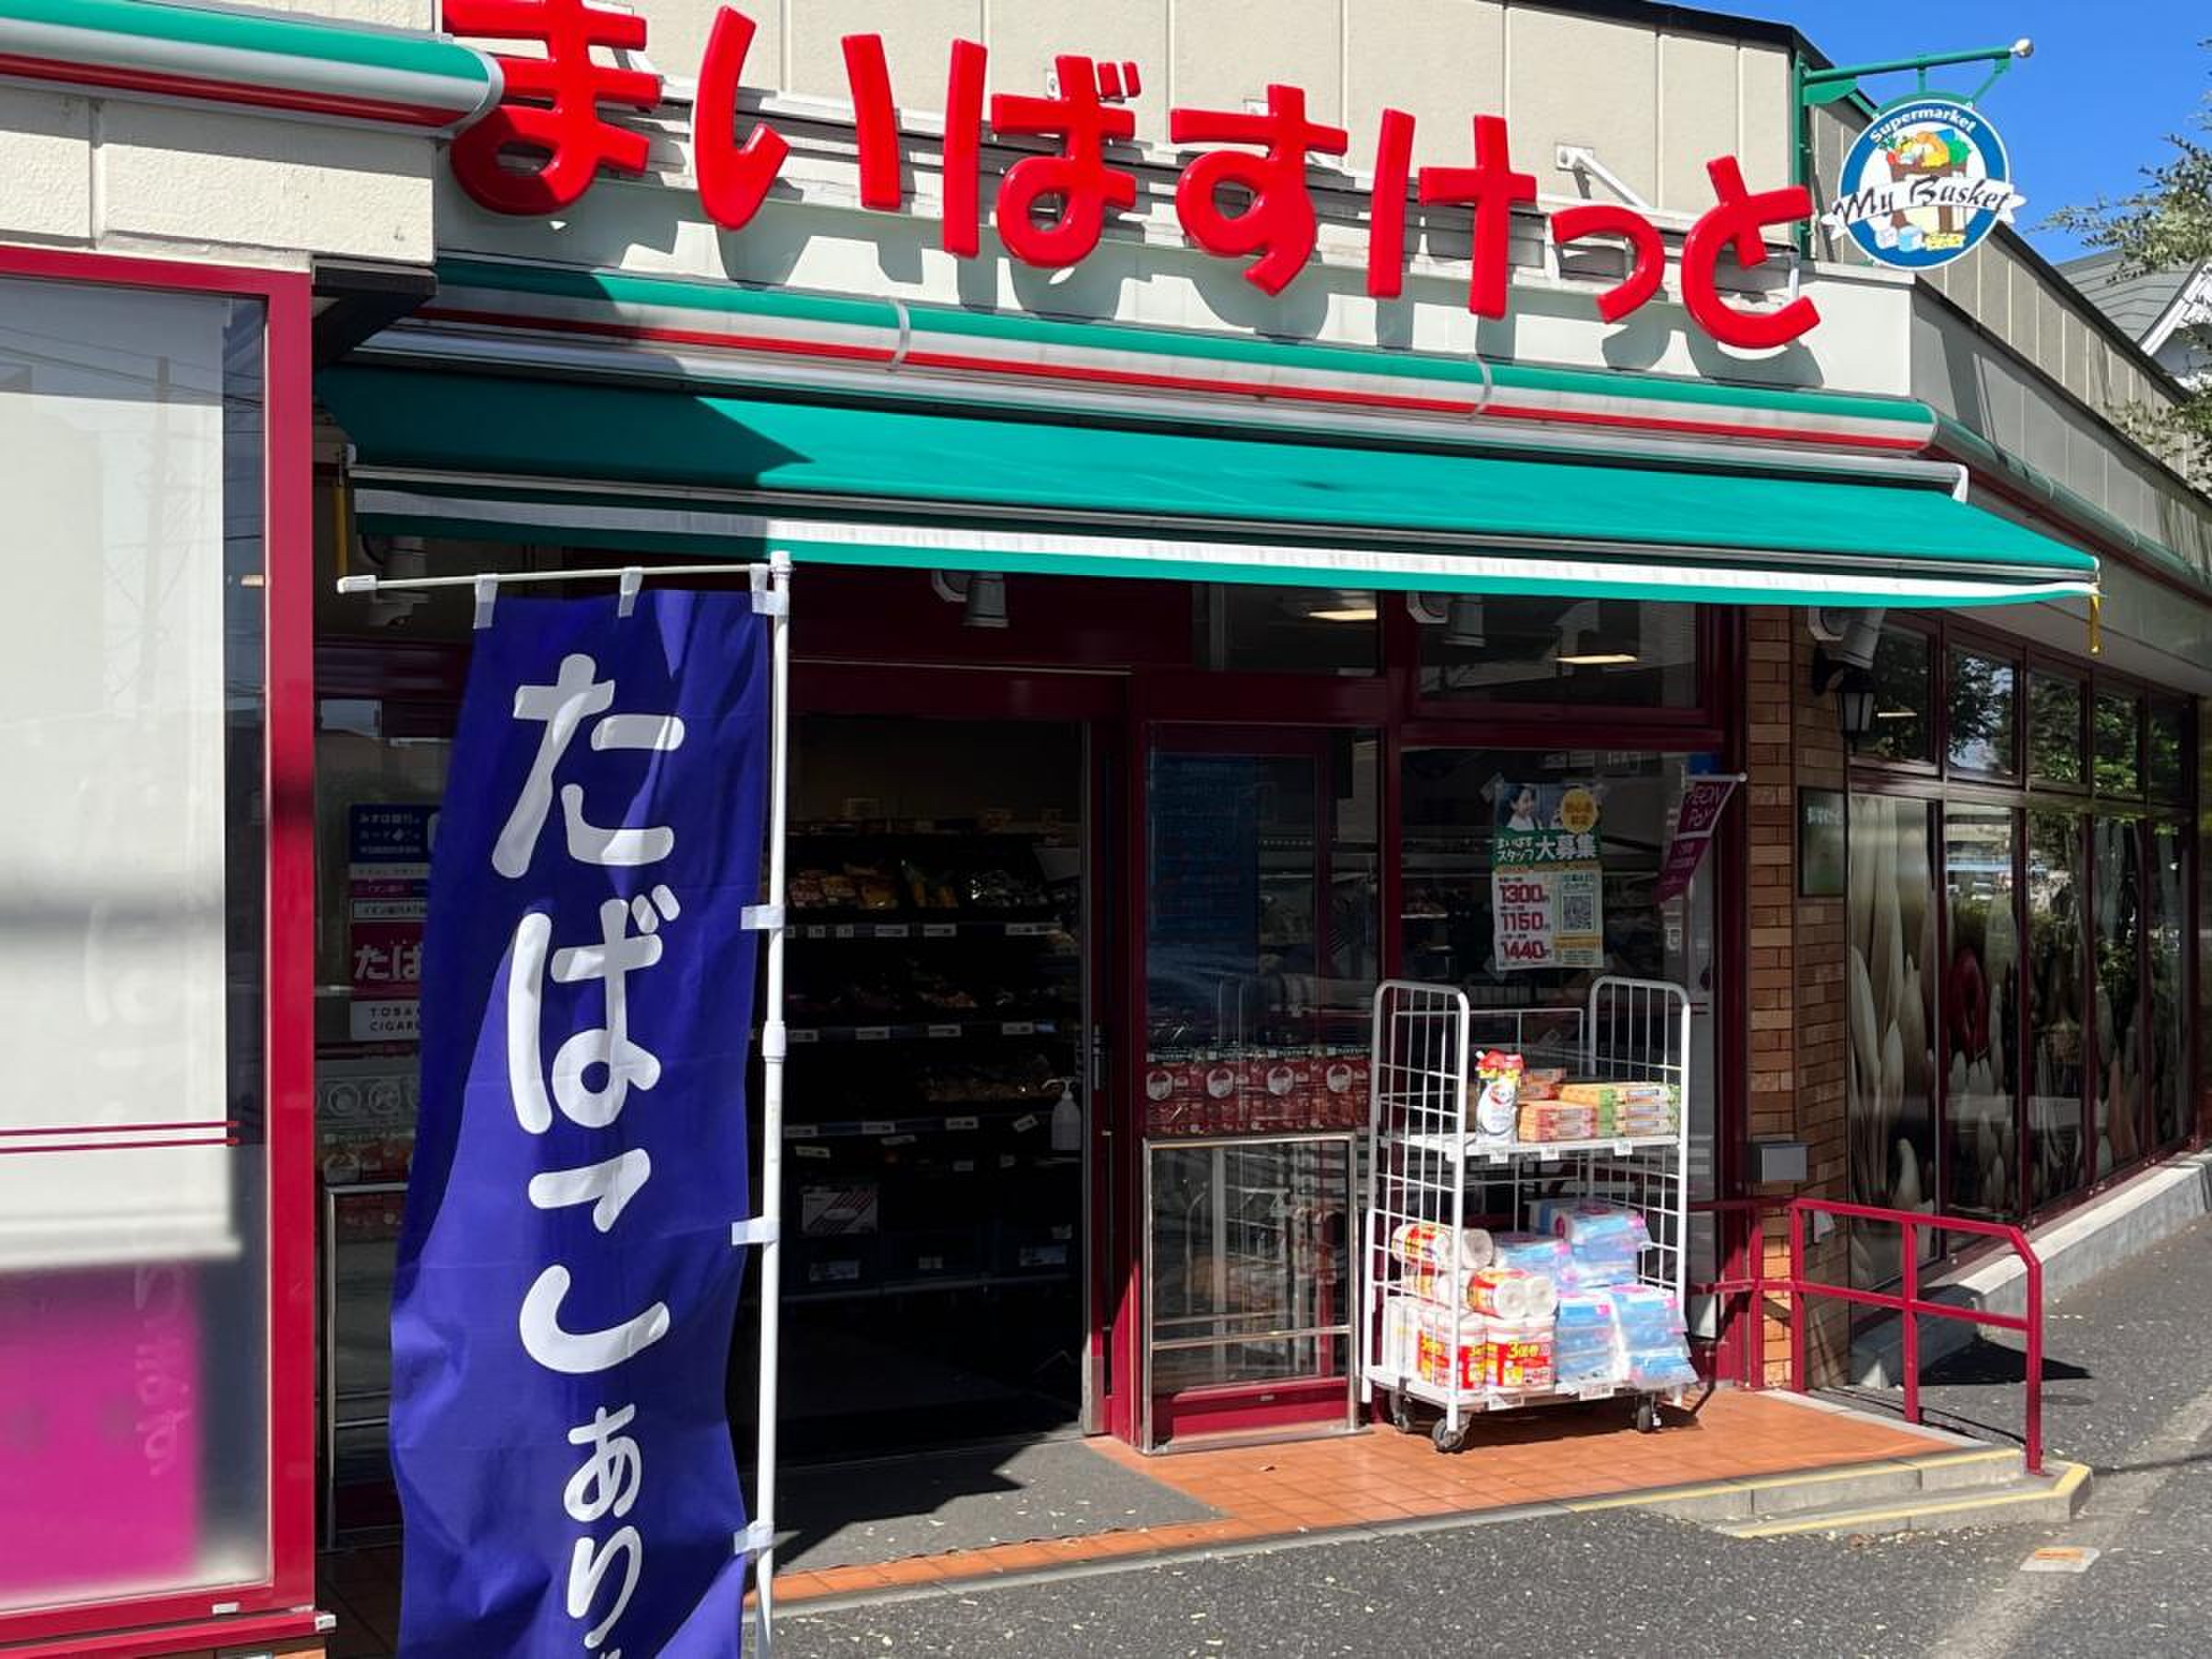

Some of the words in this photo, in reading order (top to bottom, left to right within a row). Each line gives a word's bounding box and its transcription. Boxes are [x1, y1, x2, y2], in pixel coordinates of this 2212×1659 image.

[1869, 109, 1976, 144] Supermarket
[442, 0, 1819, 349] まいばすけっと
[1832, 185, 1895, 224] My
[1909, 175, 2011, 215] Basket
[1535, 834, 1598, 861] 大募集
[490, 653, 685, 1659] たばこあり
